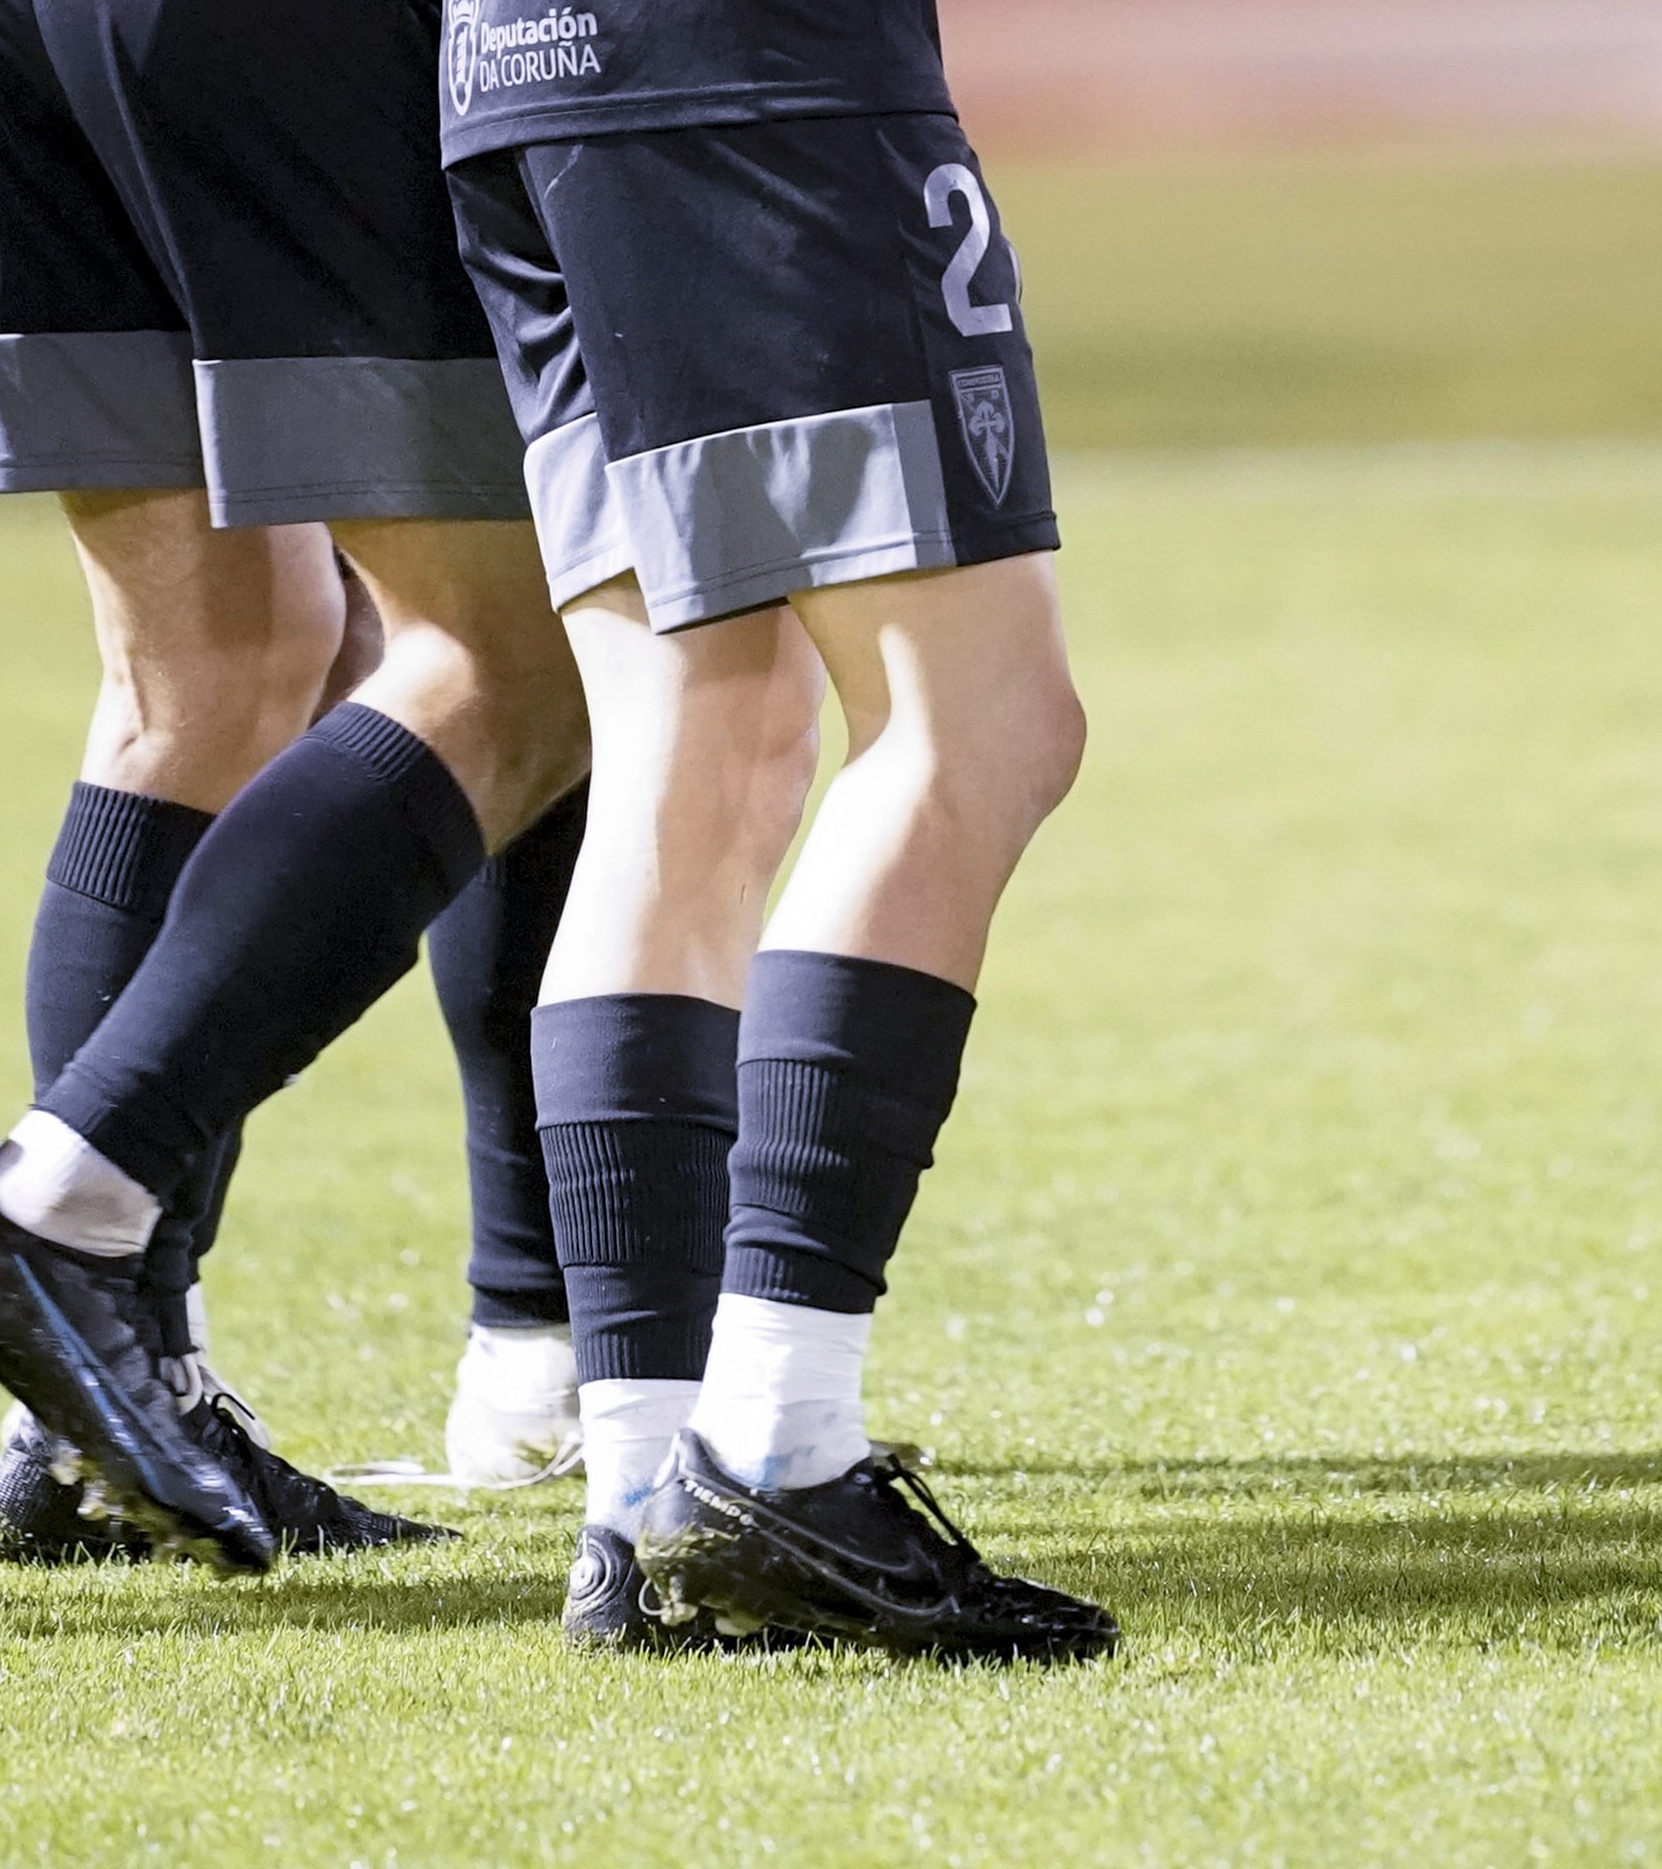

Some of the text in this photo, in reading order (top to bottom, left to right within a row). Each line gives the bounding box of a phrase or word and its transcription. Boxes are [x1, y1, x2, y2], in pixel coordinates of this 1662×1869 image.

[480, 6, 598, 59] Deputación
[480, 39, 602, 92] DA CORUÑA
